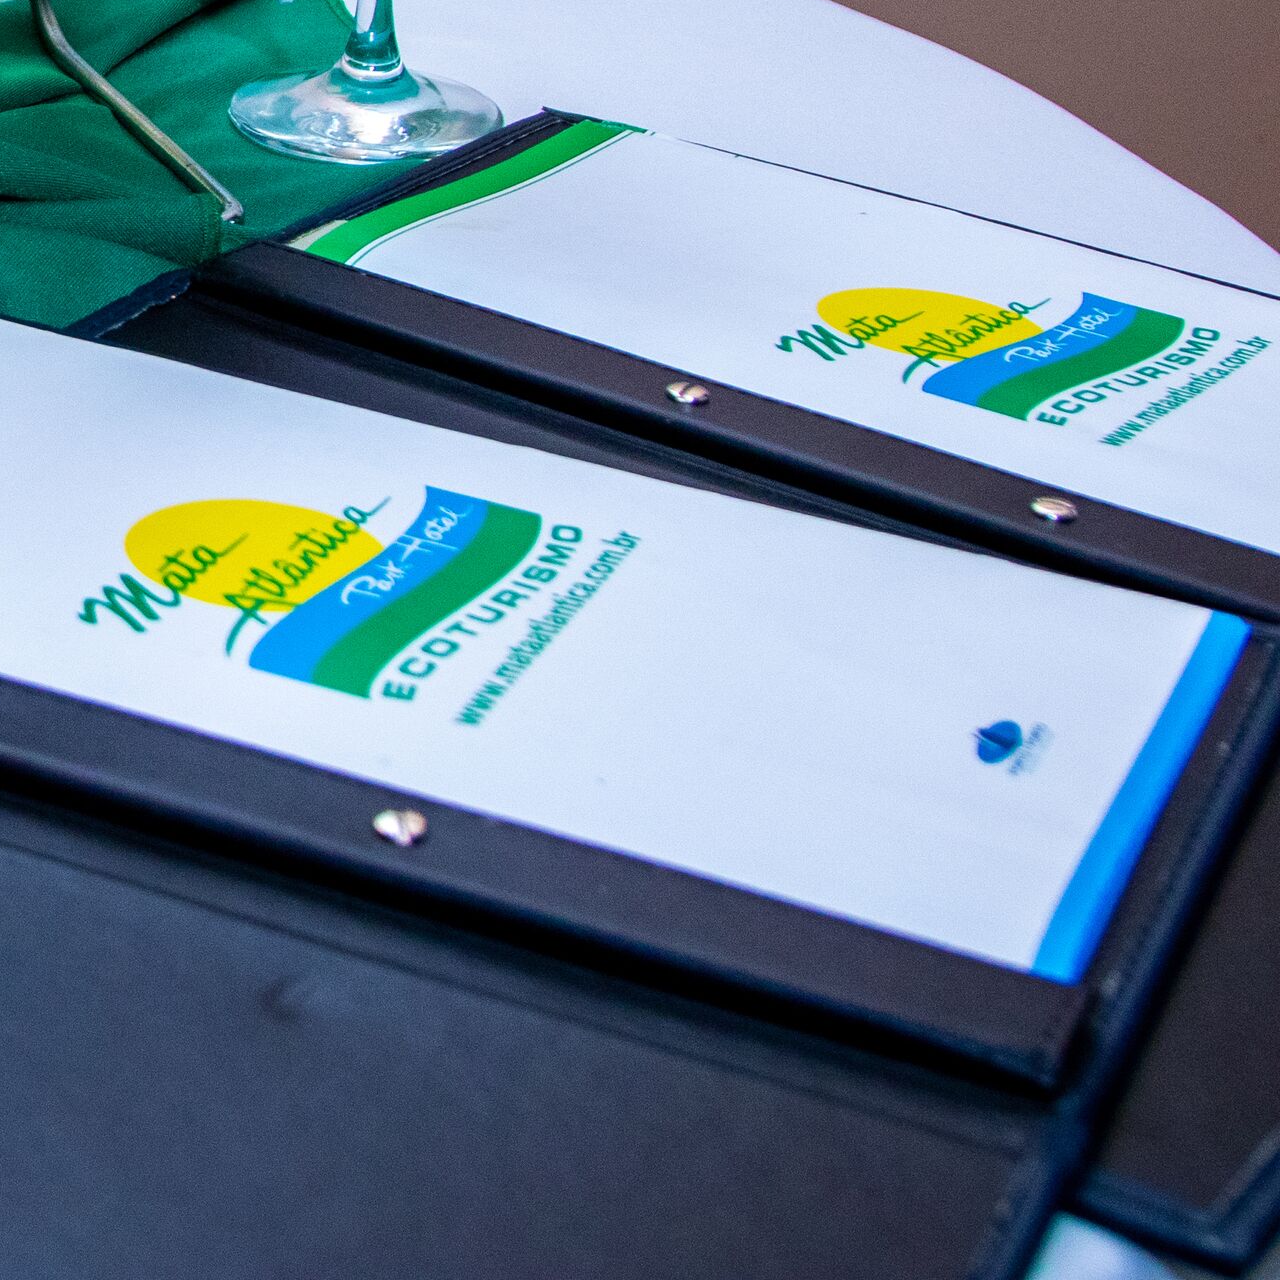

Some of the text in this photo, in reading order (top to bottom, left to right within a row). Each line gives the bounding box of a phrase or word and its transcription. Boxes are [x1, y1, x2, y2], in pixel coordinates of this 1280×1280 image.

[776, 310, 926, 362] Mata
[1036, 326, 1221, 426] ECOTURISMO
[1097, 335, 1273, 447] www.mataatlantica.com.br
[78, 532, 249, 634] Mata
[382, 524, 583, 702] ECOTURISMO
[454, 529, 642, 726] www.mataatlantica.com.br
